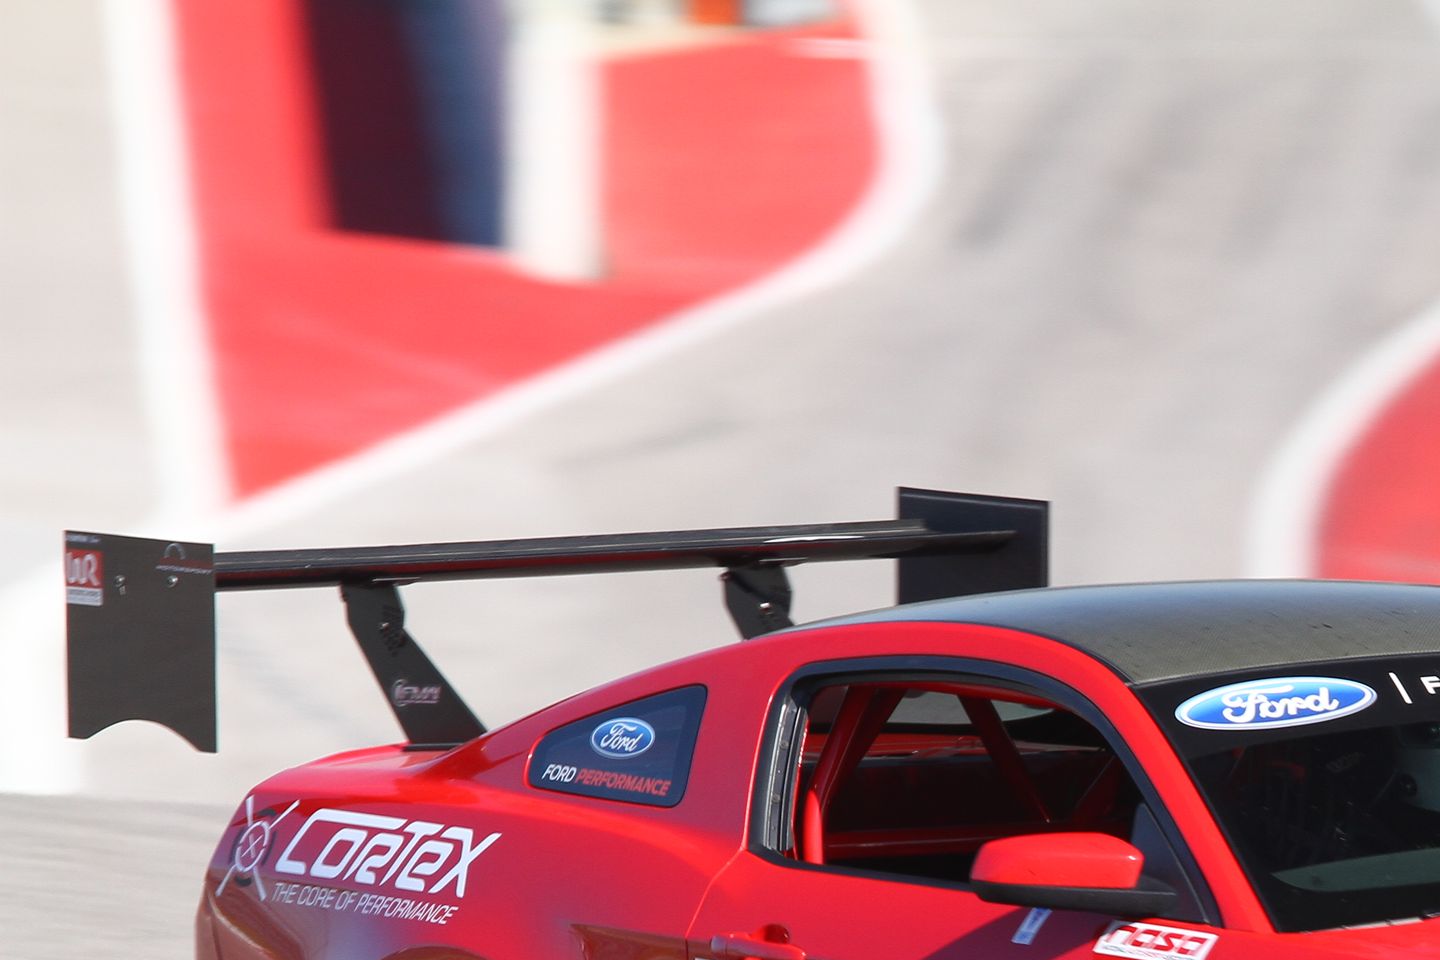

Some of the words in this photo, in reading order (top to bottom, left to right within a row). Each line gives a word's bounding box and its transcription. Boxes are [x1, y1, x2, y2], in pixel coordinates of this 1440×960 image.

[1221, 685, 1339, 723] Ford
[600, 722, 643, 752] Ford
[541, 764, 577, 783] FORD
[575, 768, 672, 796] PERFORMANCE
[271, 882, 299, 904] THE
[297, 884, 335, 909] CORE
[338, 892, 356, 911] OF
[354, 893, 458, 925] PERFORMANCE
